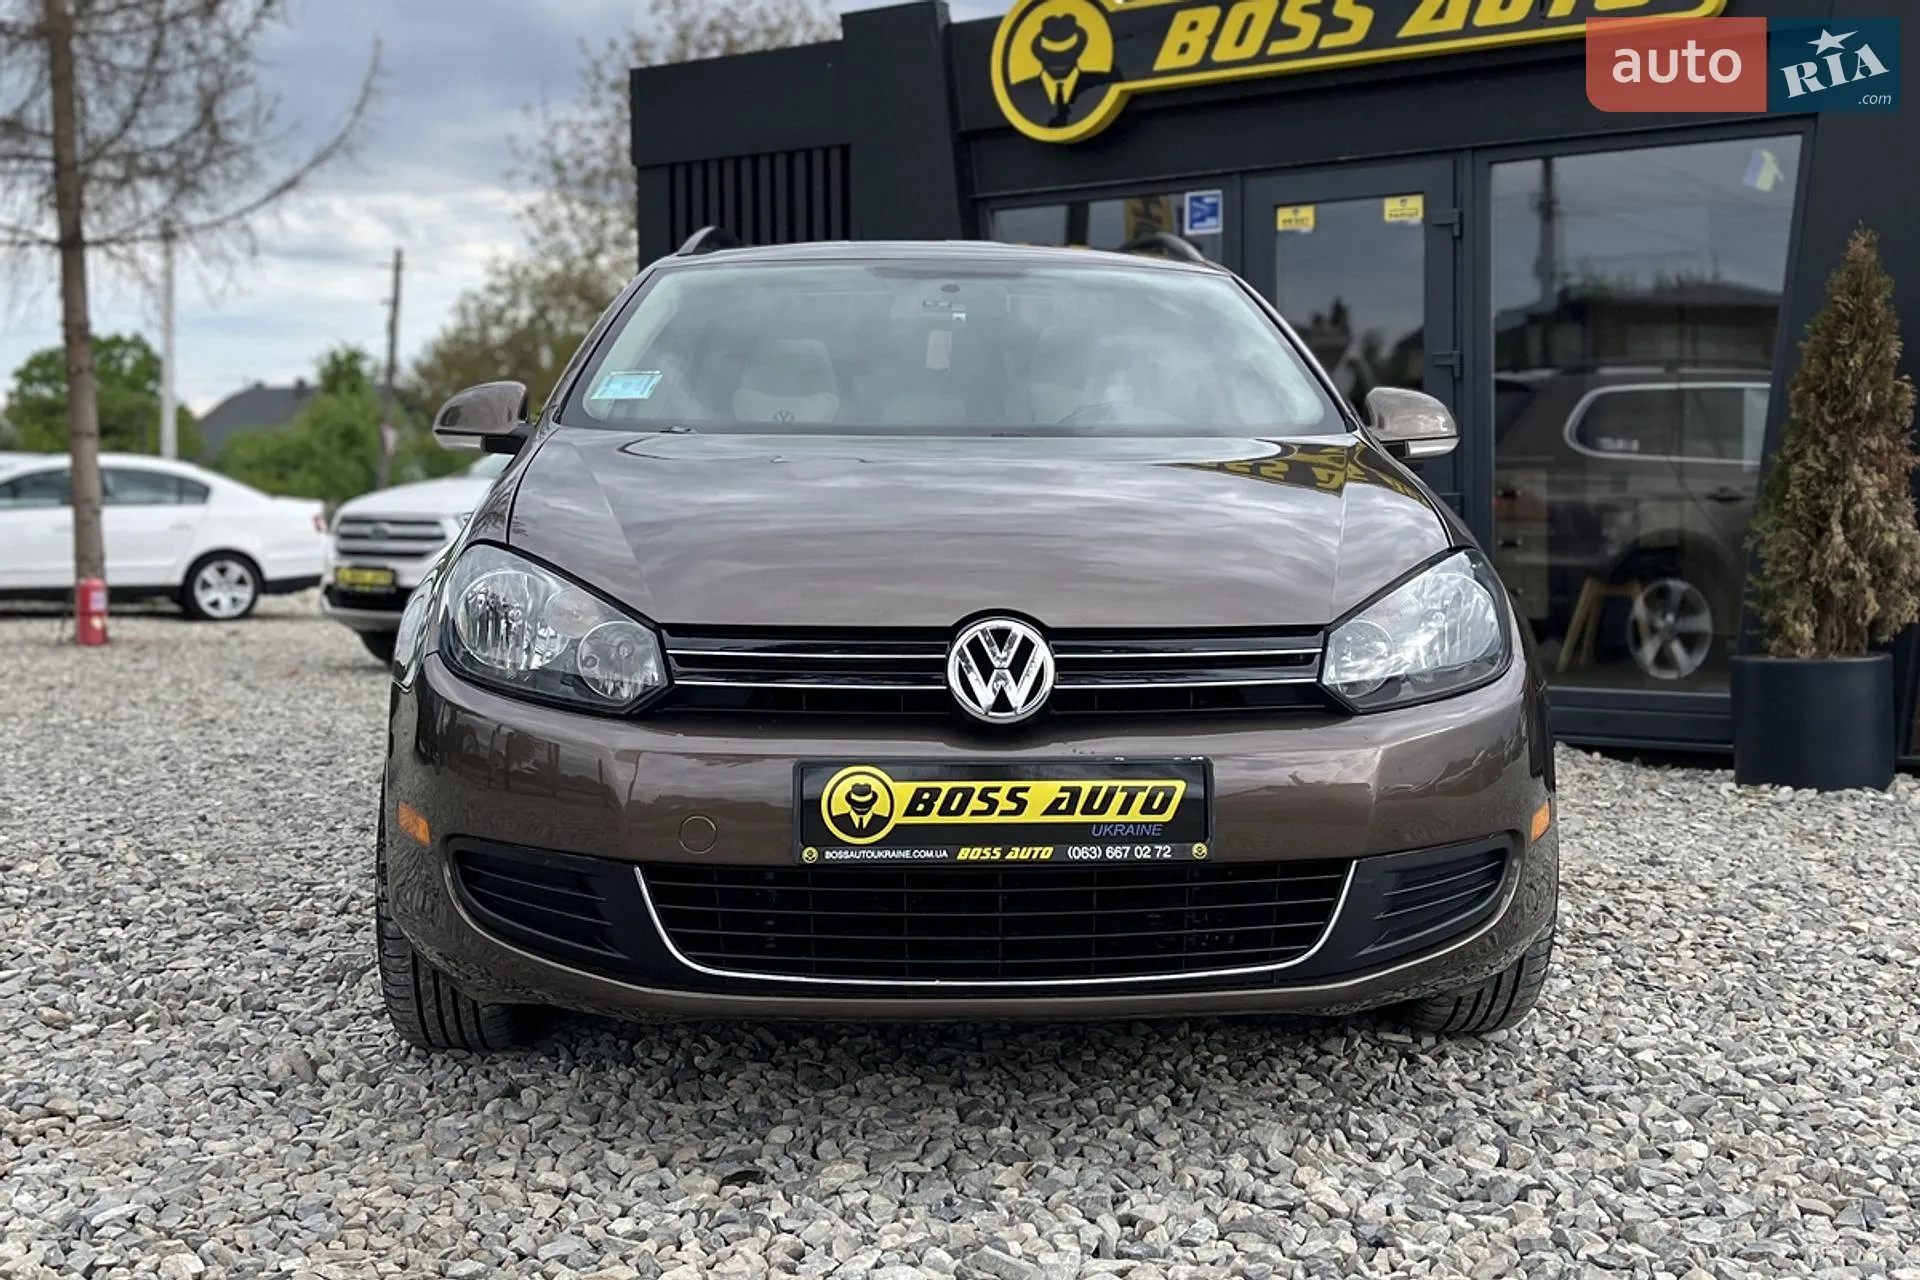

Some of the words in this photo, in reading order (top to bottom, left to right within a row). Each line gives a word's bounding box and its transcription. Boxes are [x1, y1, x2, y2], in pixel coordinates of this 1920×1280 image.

[1152, 0, 1375, 72] BOSS
[903, 787, 1031, 817] BOSS
[1040, 786, 1176, 817] AUTO
[1091, 823, 1163, 837] UKRAINE
[956, 847, 1001, 860] BOSS
[1005, 847, 1054, 860] AUTO
[1067, 846, 1102, 860] (063)
[1105, 846, 1130, 859] 667
[1134, 846, 1151, 859] 02
[1154, 845, 1172, 858] 72
